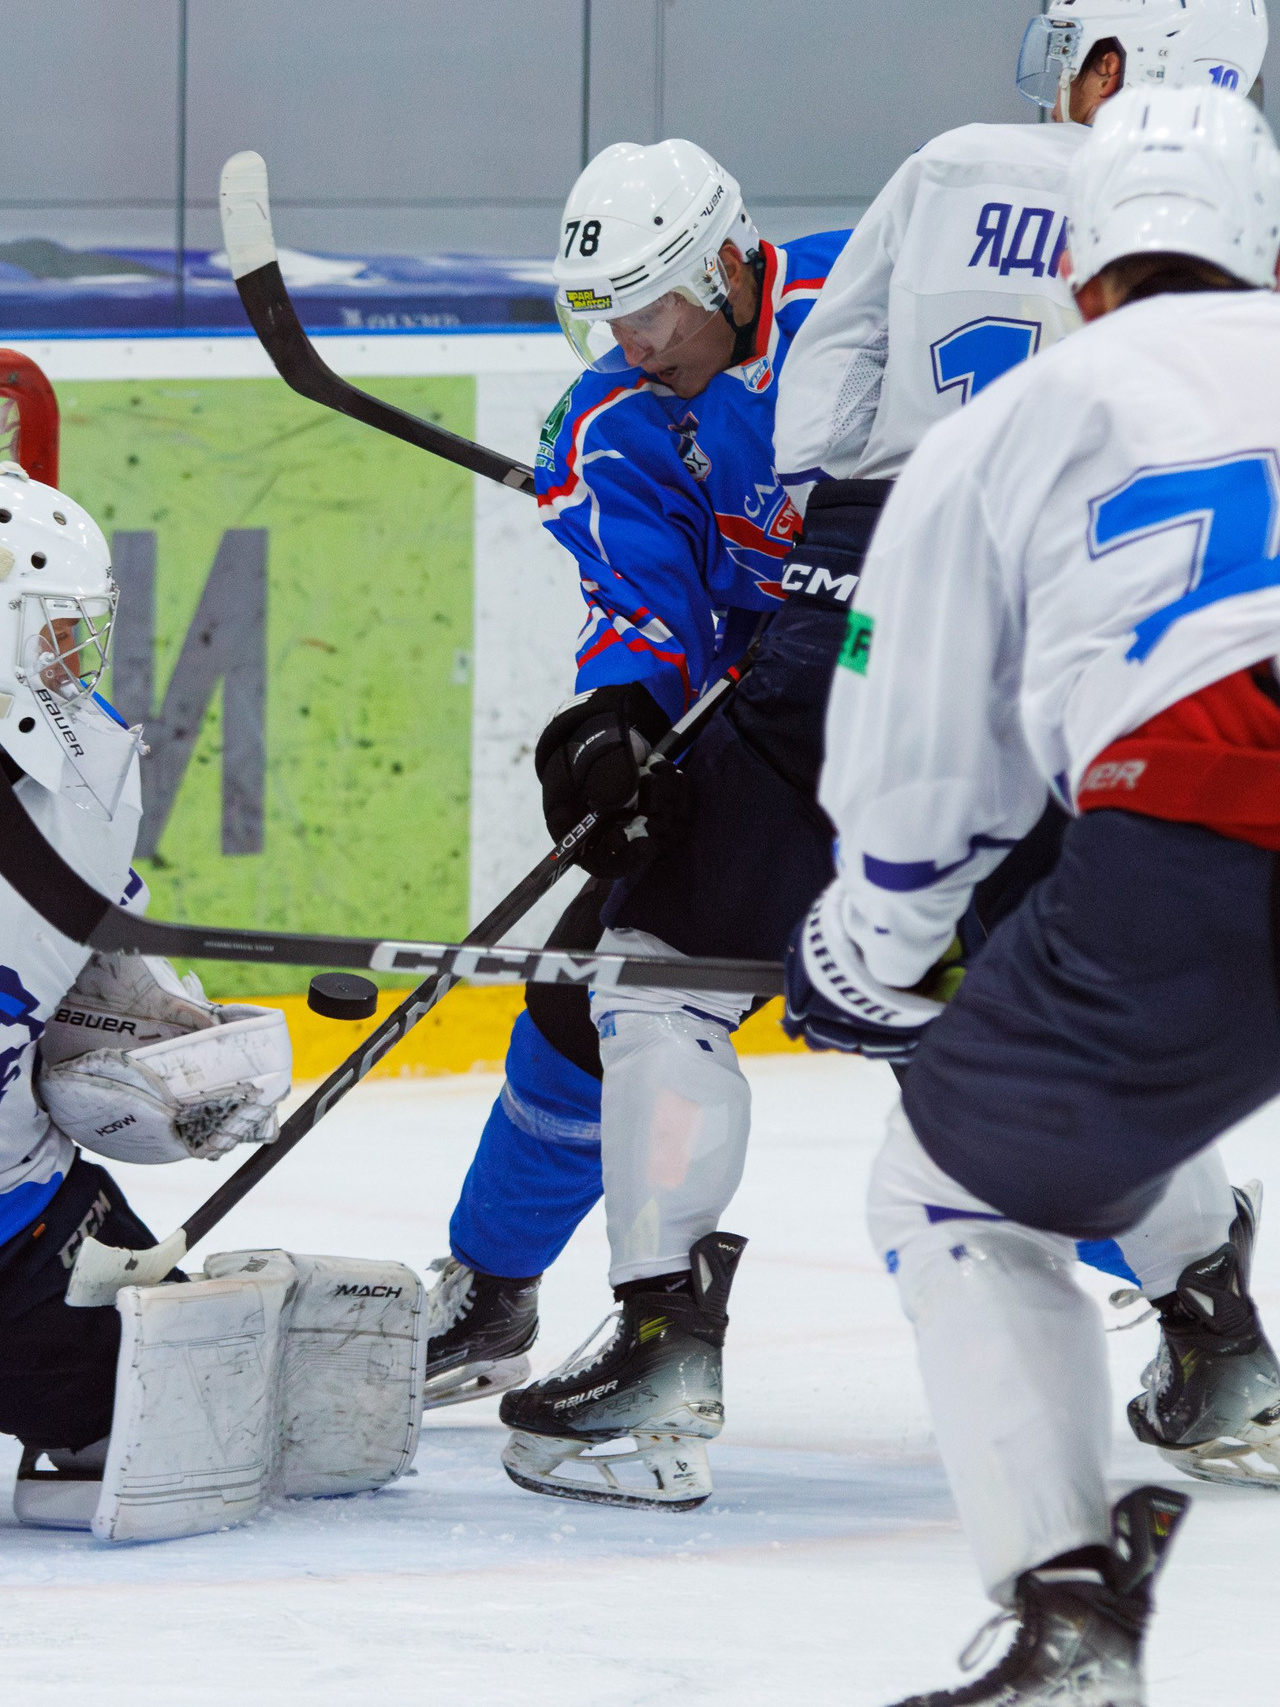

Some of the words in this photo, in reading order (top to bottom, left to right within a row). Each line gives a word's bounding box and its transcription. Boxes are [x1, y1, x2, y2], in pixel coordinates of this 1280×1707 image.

[1208, 64, 1239, 92] 10
[564, 219, 602, 258] 78
[781, 563, 860, 602] CM
[36, 688, 84, 757] BAUER
[369, 941, 625, 986] CCM
[54, 1008, 137, 1036] BAUER
[95, 1114, 138, 1137] MACH
[334, 1284, 403, 1299] MACH
[553, 1379, 619, 1412] BAUER
